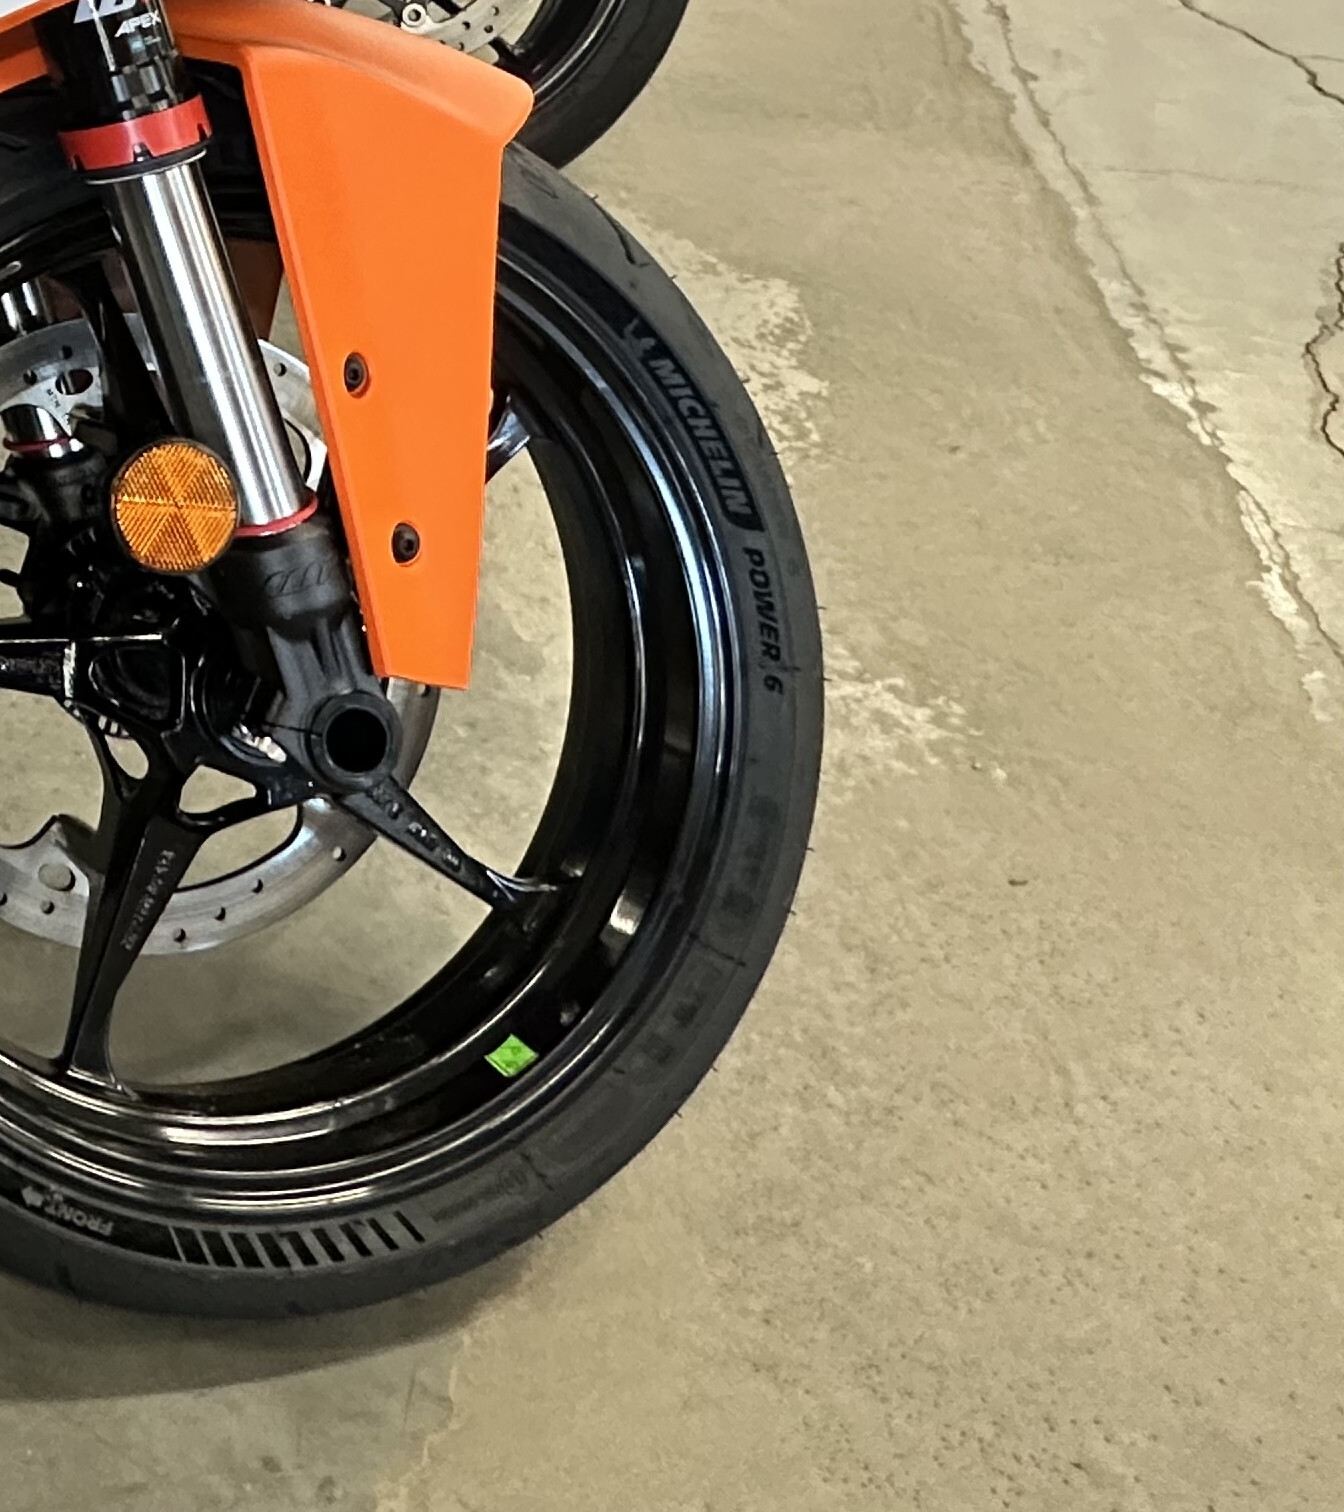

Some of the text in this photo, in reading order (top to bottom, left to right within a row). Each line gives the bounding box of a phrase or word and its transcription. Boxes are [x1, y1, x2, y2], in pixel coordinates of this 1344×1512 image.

[650, 357, 784, 696] MICHELIN POWER 6
[44, 1200, 114, 1237] FRONT
